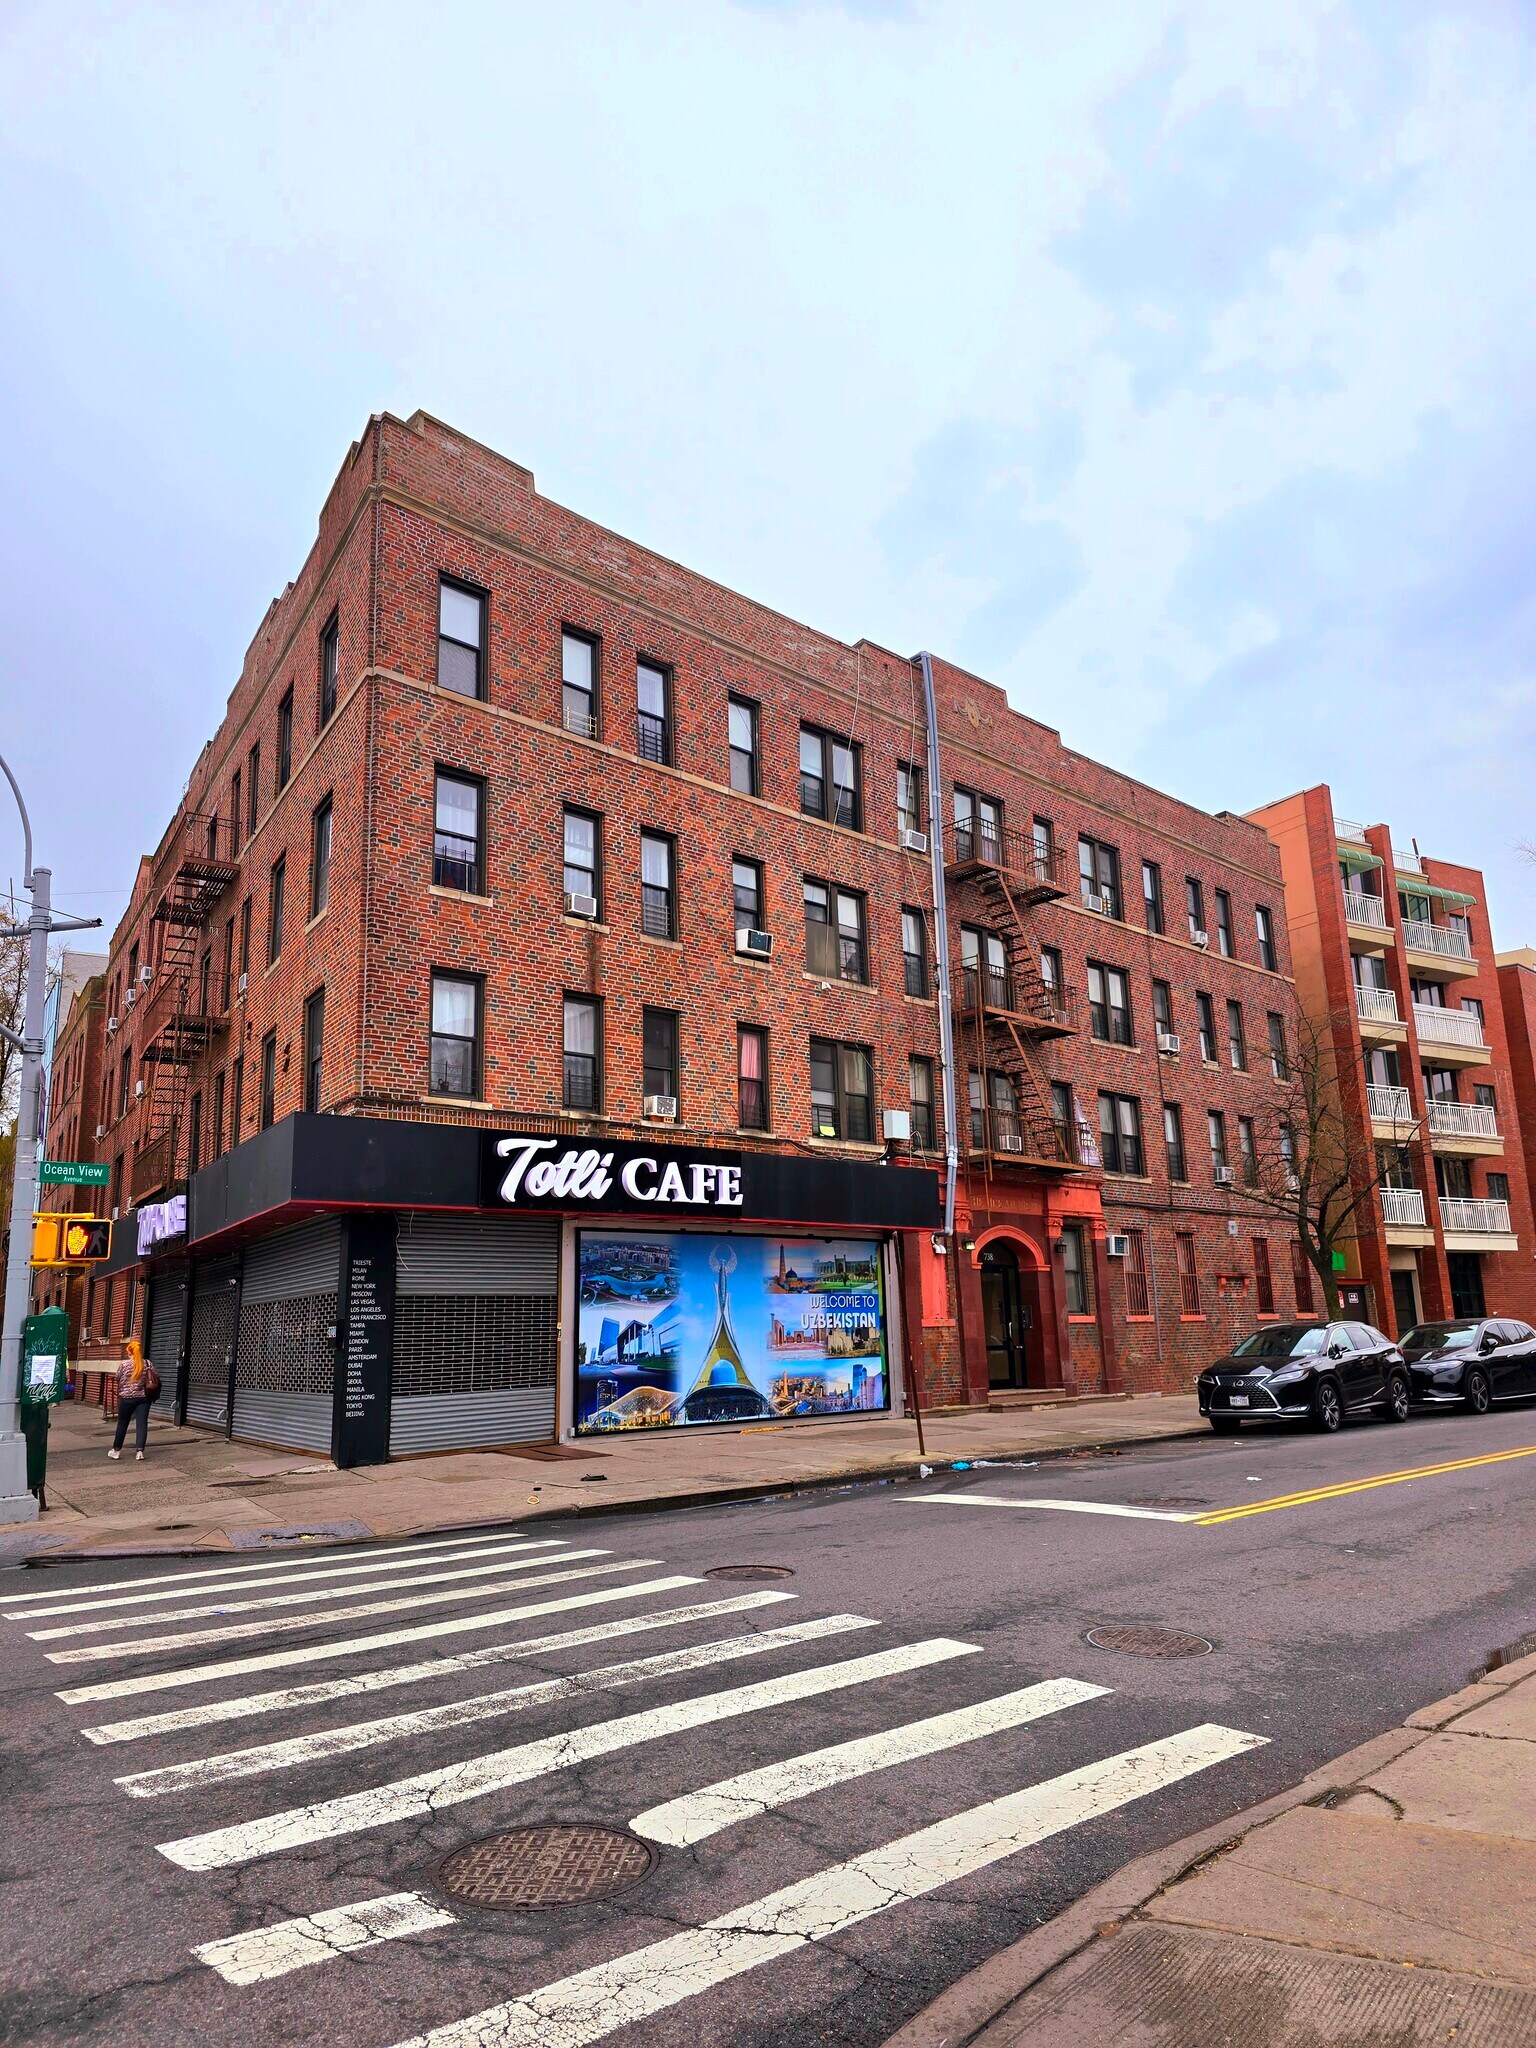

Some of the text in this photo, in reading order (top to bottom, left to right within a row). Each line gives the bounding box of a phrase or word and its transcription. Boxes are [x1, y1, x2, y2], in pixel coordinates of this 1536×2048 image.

[44, 1163, 103, 1177] Ocean View
[494, 1138, 744, 1205] Totli CAFE
[983, 1252, 994, 1261] 738
[811, 1295, 876, 1308] WELCOME TO
[801, 1312, 877, 1330] UZBEKISTAN
